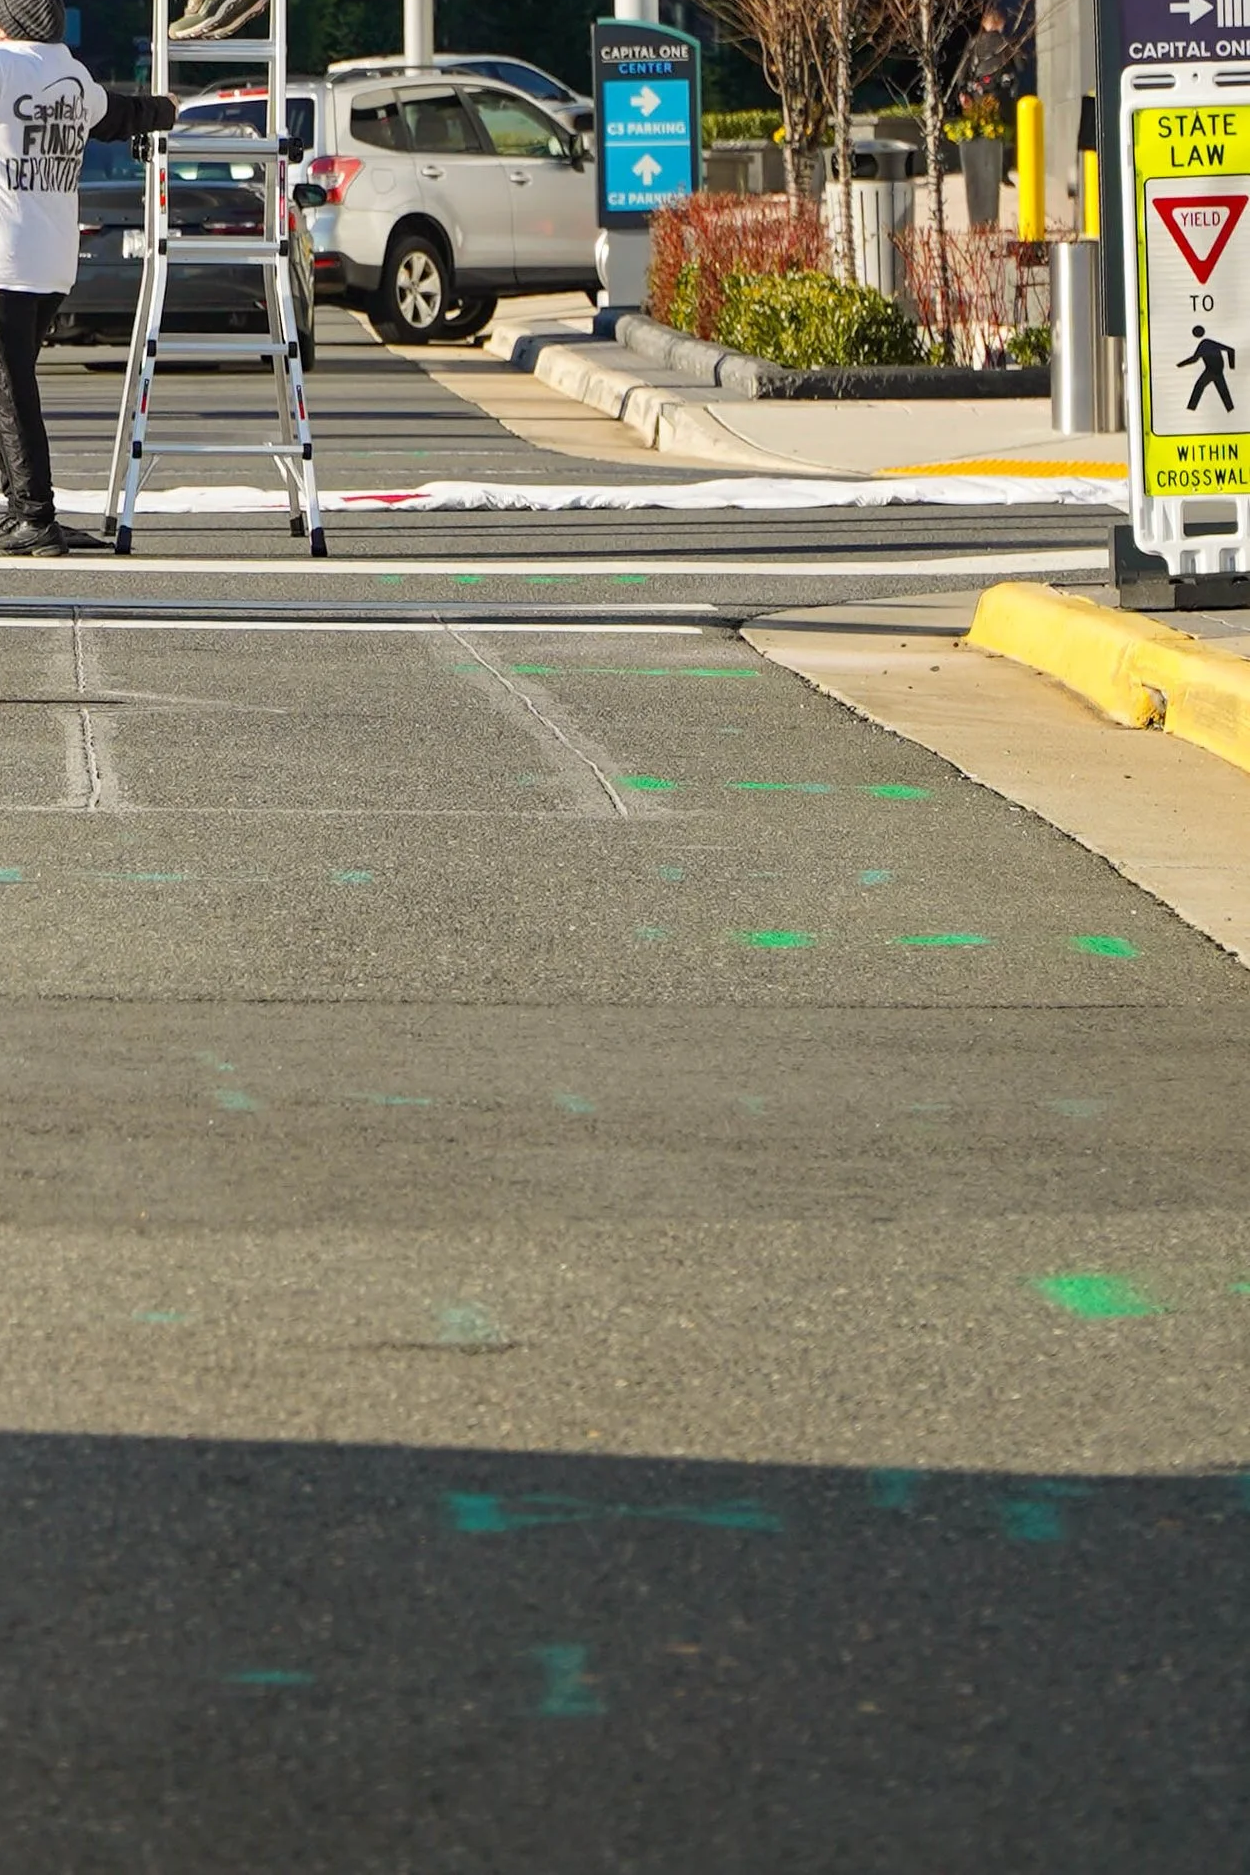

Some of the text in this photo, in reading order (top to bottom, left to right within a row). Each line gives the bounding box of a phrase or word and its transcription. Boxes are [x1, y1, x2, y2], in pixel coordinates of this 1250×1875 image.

[600, 44, 689, 60] CAPITAL ONE
[1129, 41, 1211, 59] CAPITAL
[618, 61, 673, 74] CENTER
[627, 120, 687, 135] PARKING
[1158, 112, 1237, 138] STATE
[23, 123, 85, 156] FUNDS
[1170, 144, 1225, 167] LAW
[1180, 211, 1221, 227] YIELD
[1189, 294, 1215, 313] TO
[1177, 443, 1238, 462] WITHIN
[1156, 467, 1250, 488] CROSSWAL
